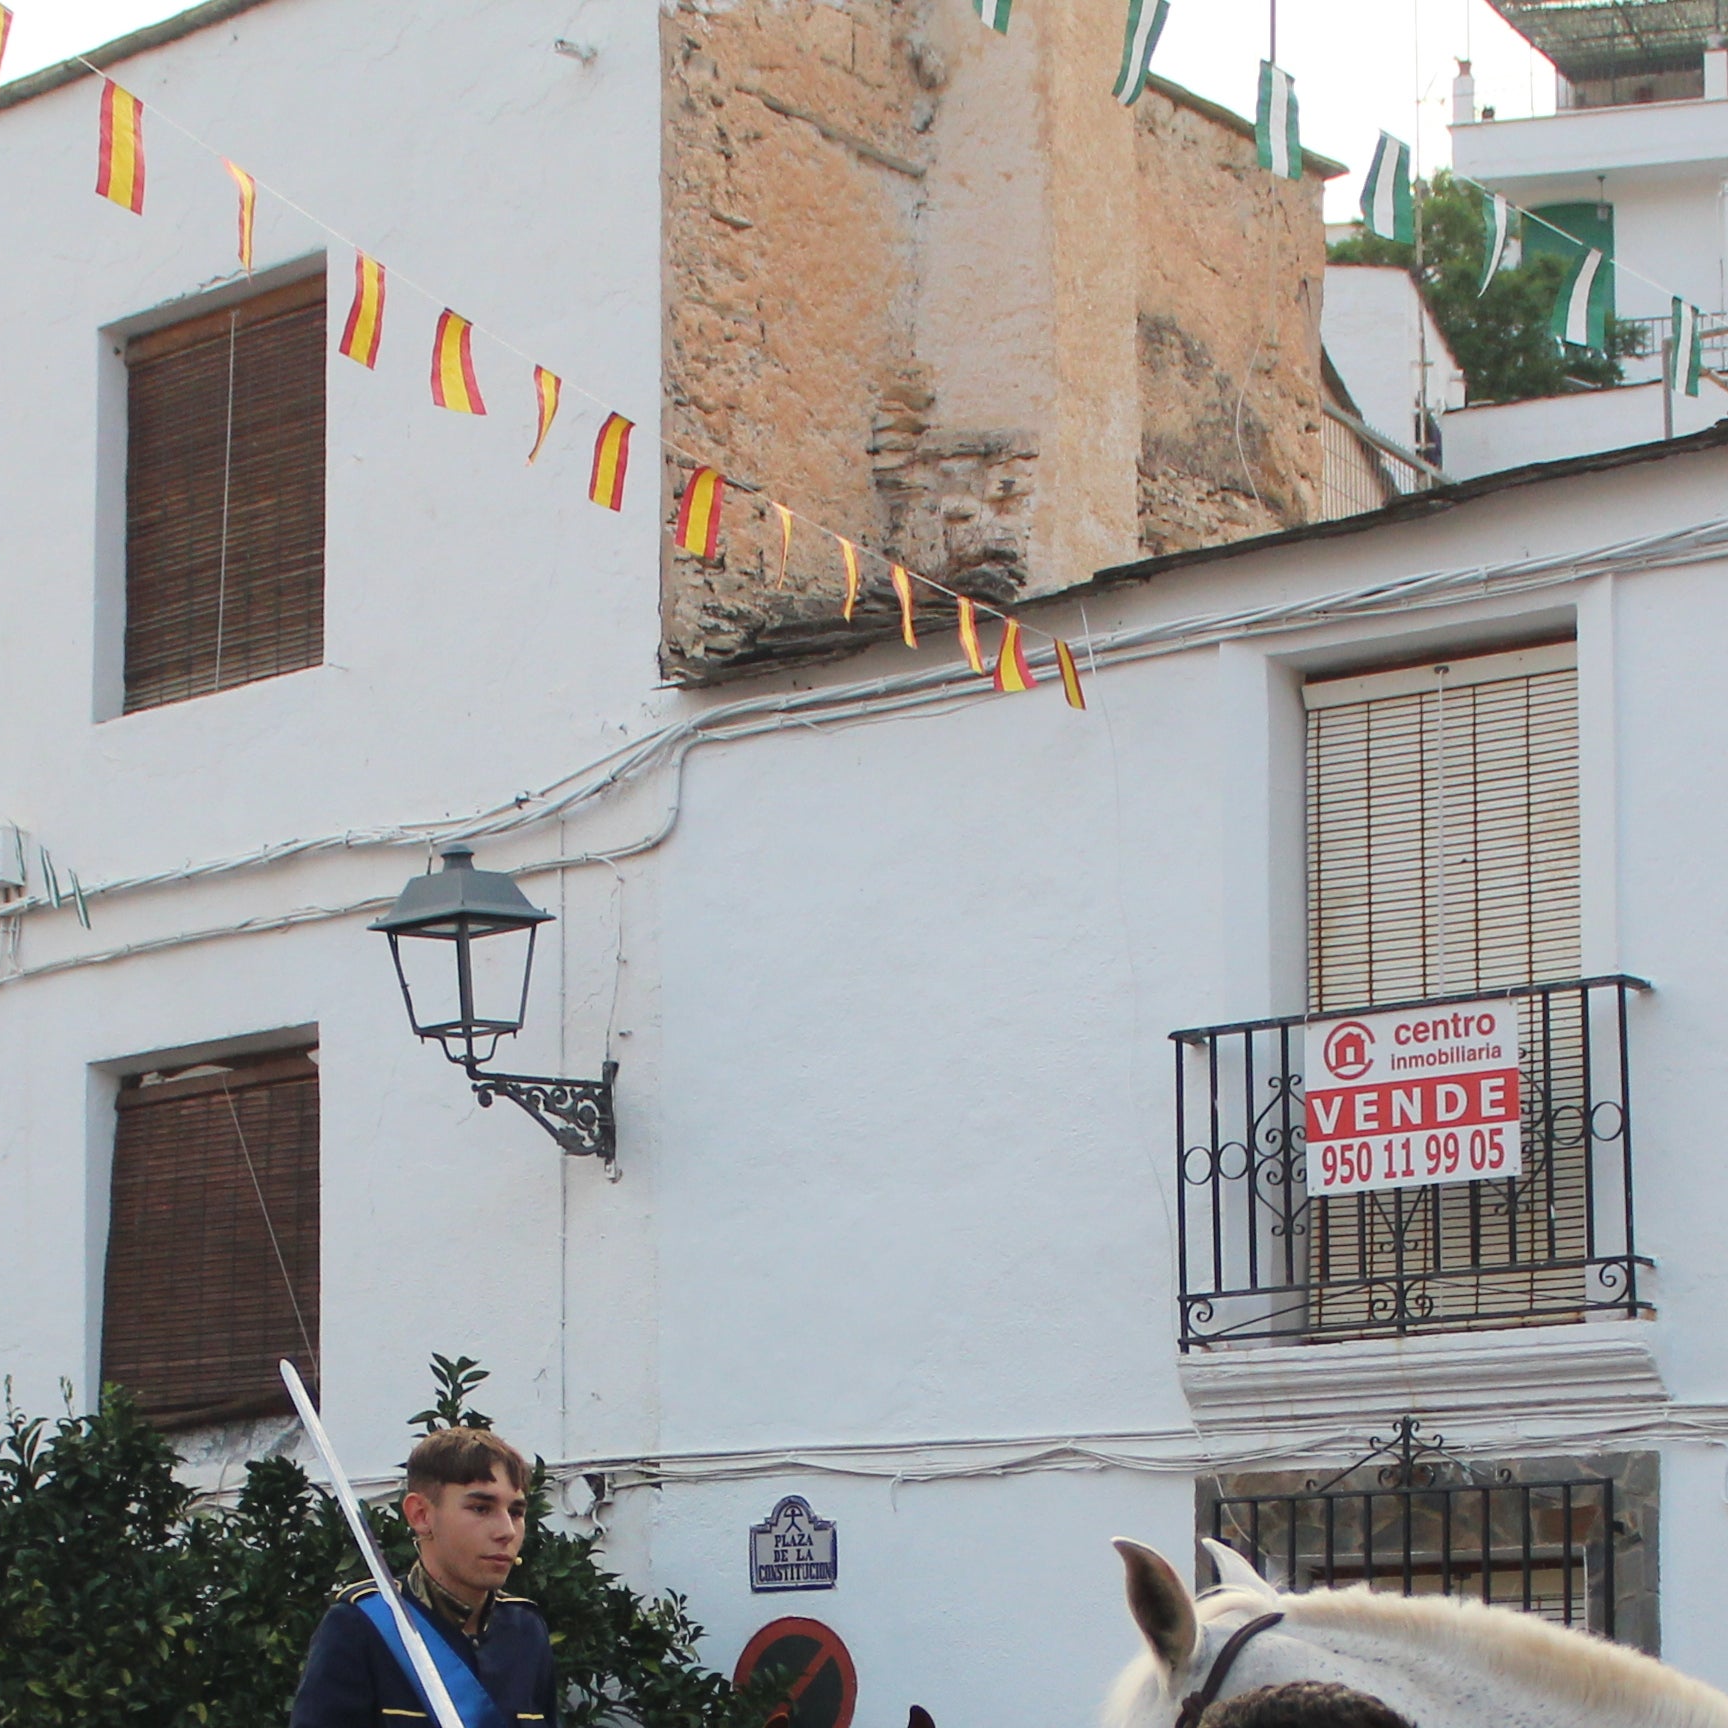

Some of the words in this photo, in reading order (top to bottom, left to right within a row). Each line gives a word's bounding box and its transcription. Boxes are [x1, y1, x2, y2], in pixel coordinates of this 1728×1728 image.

[1394, 1012, 1496, 1046] centro
[1390, 1043, 1502, 1070] inmobiliaria
[1312, 1078, 1506, 1135] VENDE
[1322, 1140, 1372, 1186] 950
[1383, 1138, 1414, 1179] 11
[1425, 1132, 1460, 1176] 99
[1470, 1128, 1505, 1170] 05
[774, 1534, 813, 1548] PLAZA
[774, 1550, 788, 1562] DE
[796, 1549, 814, 1561] LA
